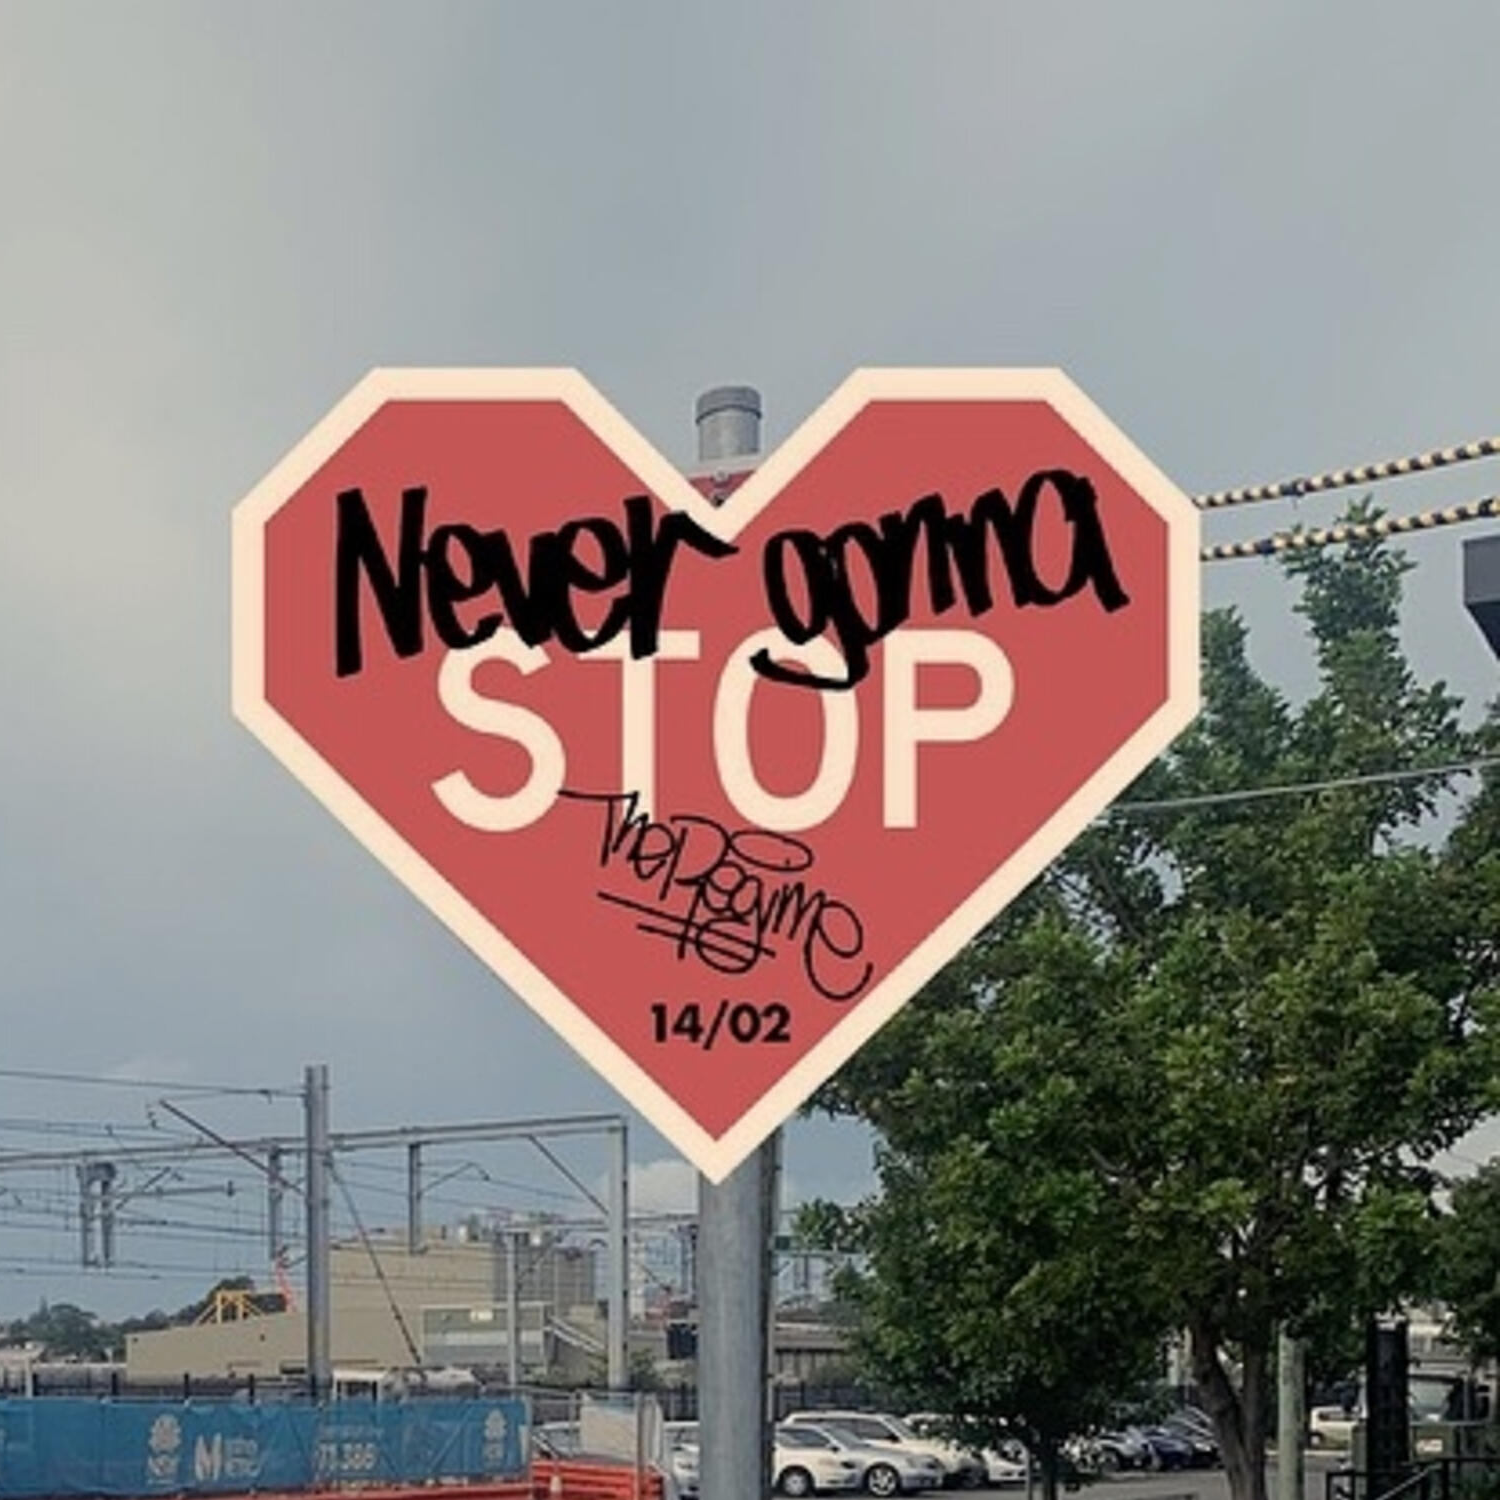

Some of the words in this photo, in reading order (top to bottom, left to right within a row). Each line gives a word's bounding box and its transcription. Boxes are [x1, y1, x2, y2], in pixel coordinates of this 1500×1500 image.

[336, 487, 739, 677] Never
[750, 469, 1130, 691] gonna
[431, 627, 1016, 833] STOP
[651, 1000, 791, 1051] 14/02
